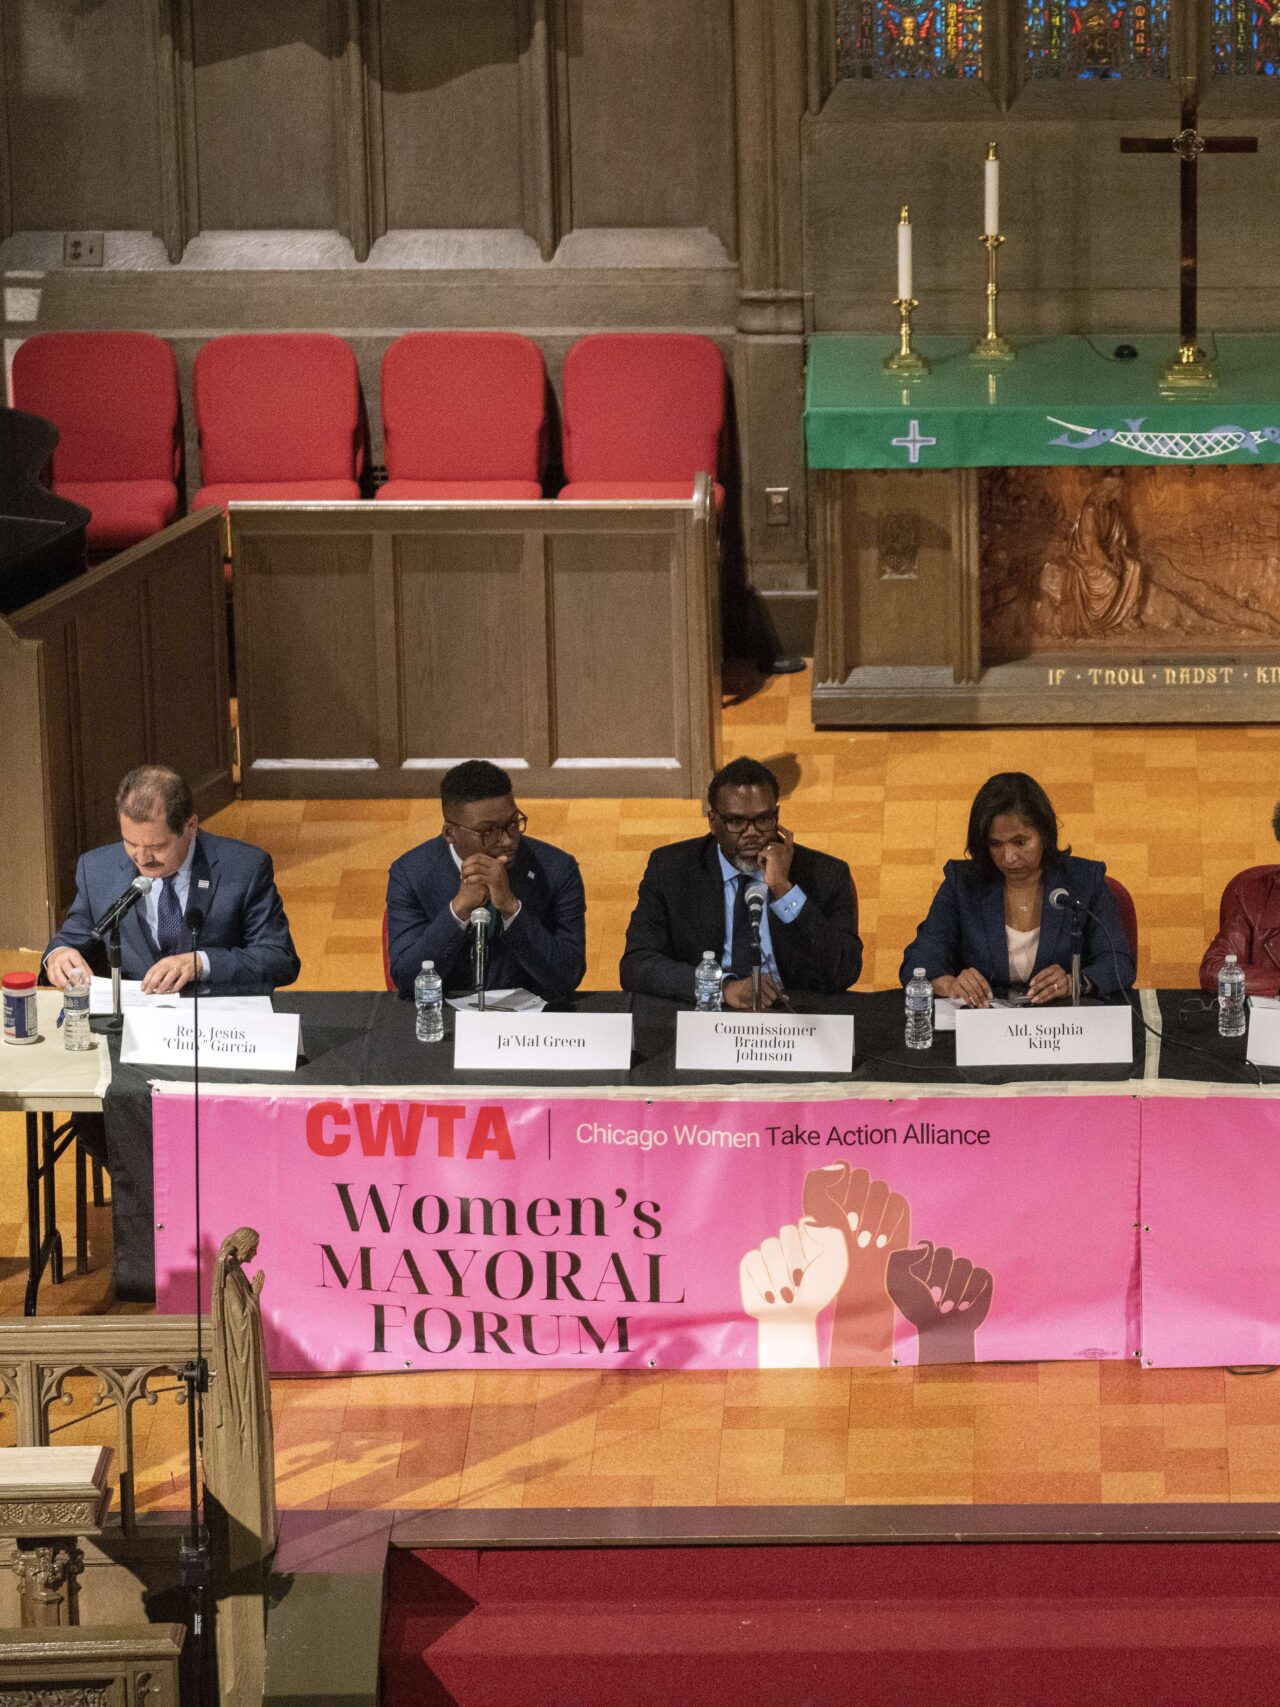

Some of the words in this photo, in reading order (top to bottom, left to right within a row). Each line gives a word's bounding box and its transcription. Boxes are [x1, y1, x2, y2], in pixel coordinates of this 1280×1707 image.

[1049, 669, 1064, 685] IF
[210, 1027, 246, 1041] Jesús
[714, 1022, 817, 1037] Commissioner
[1004, 1024, 1032, 1037] Ald.
[1035, 1023, 1083, 1040] Sophia
[497, 1034, 540, 1050] Ja'Mal
[543, 1035, 586, 1048] Green
[735, 1036, 796, 1049] Brandon
[1028, 1037, 1061, 1051] King
[736, 1049, 793, 1064] Johnson
[306, 1102, 516, 1160] CWTA
[576, 1123, 668, 1151] Chicago
[673, 1124, 760, 1149] Women
[765, 1124, 820, 1146] Take
[826, 1123, 897, 1147] Action
[903, 1123, 991, 1146] Alliance
[331, 1182, 663, 1240] Women's
[312, 1243, 686, 1304] MAYORAL
[367, 1303, 637, 1356] FORUM
